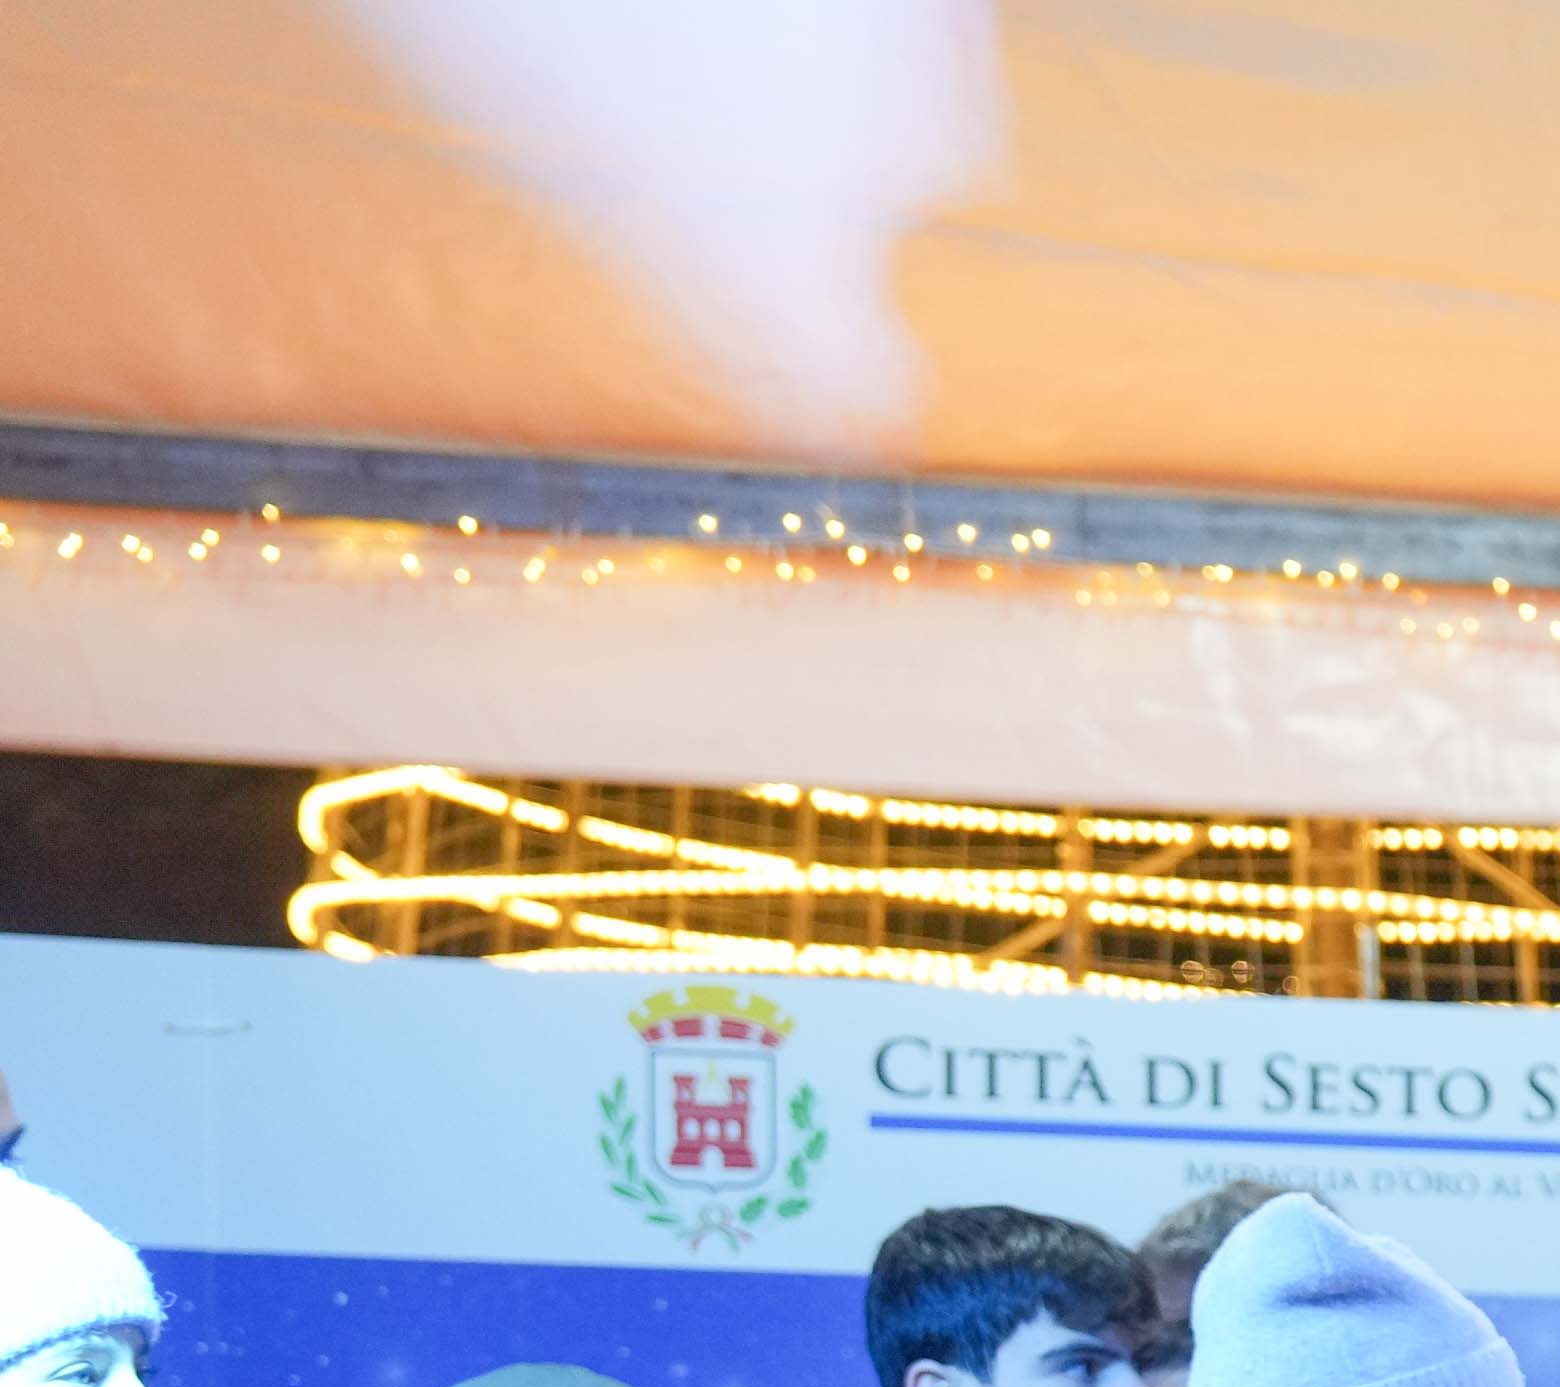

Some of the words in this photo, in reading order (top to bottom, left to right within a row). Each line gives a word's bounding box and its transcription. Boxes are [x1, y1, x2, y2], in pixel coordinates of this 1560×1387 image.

[873, 1035, 1113, 1106] CITTÀ
[1143, 1055, 1226, 1110] DI
[1261, 1051, 1491, 1121] SESTO
